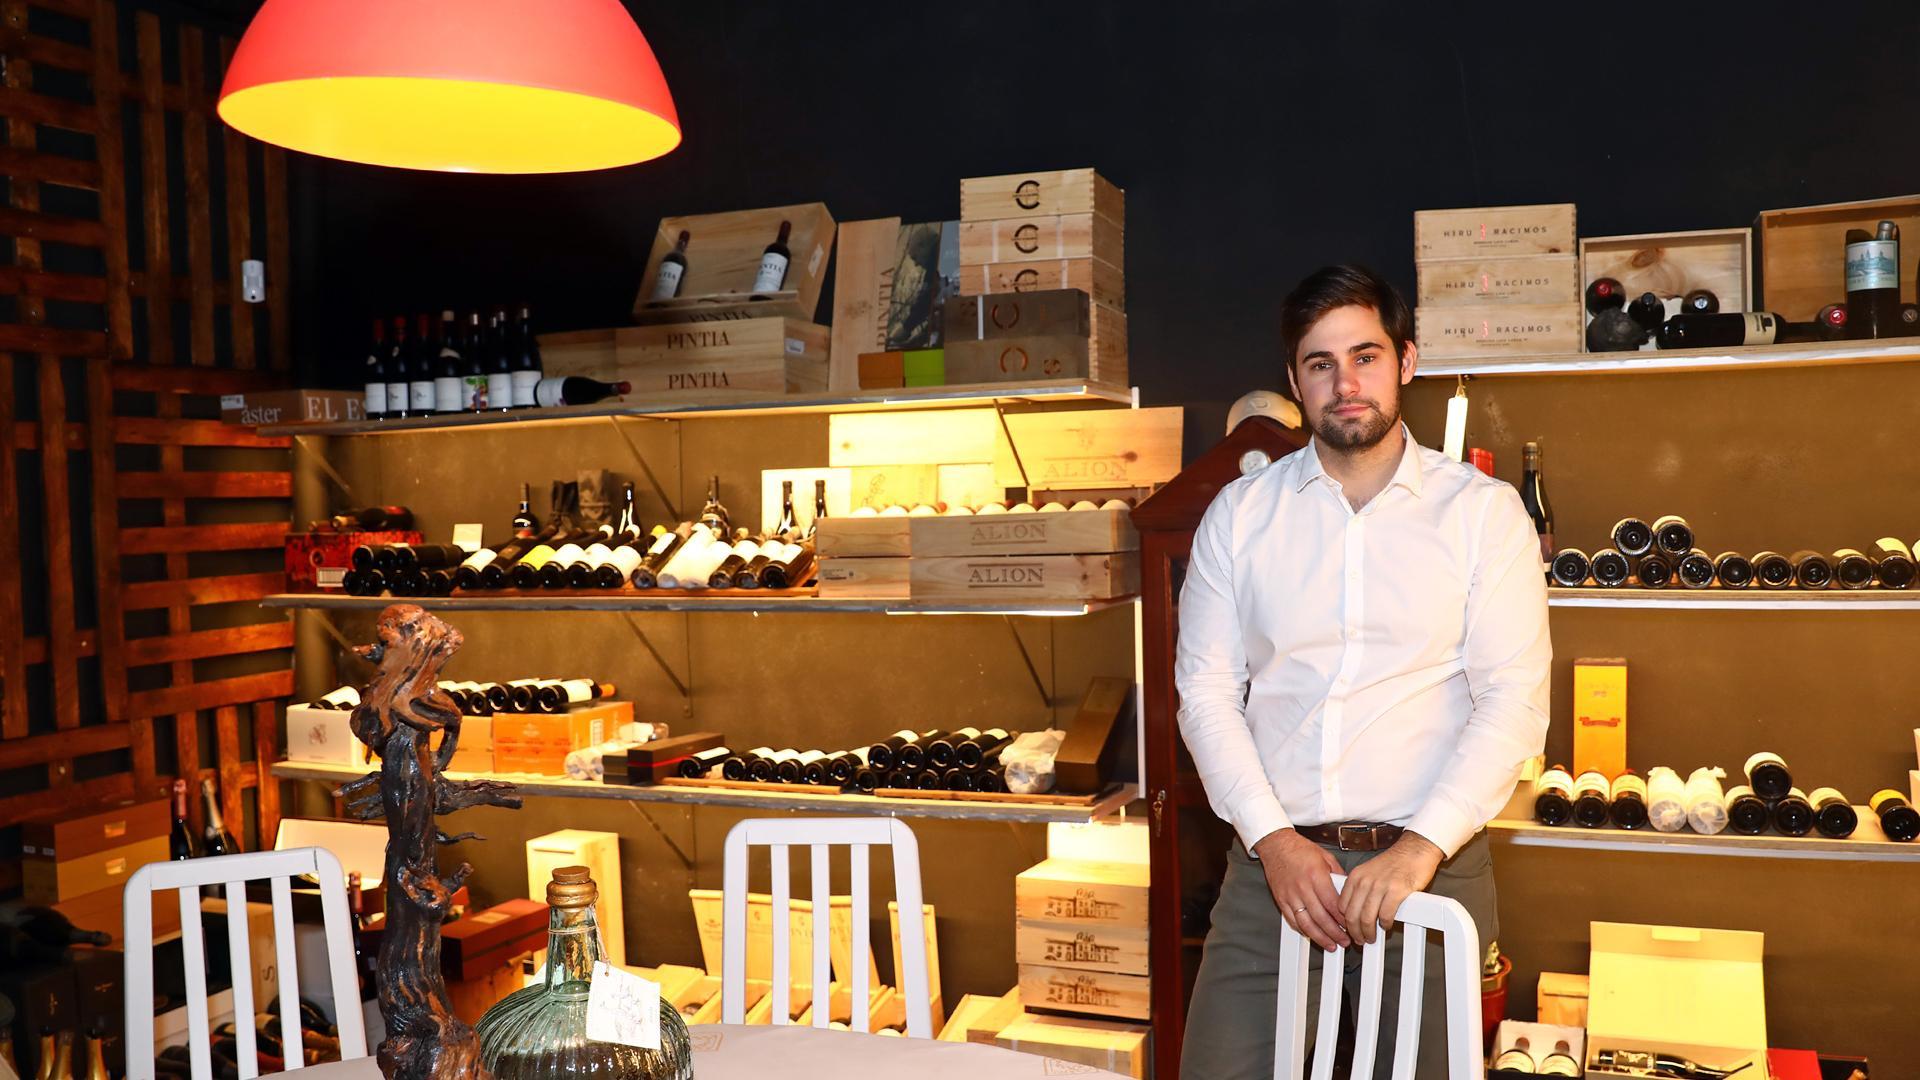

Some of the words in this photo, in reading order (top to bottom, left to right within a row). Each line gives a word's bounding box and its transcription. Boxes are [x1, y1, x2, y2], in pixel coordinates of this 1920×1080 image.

[1493, 226, 1547, 235] RACIMOS
[1445, 281, 1474, 289] HIRU
[1495, 278, 1549, 287] RACIMOS
[878, 267, 895, 347] PINTIA
[1496, 325, 1551, 333] RACIMOS
[666, 331, 730, 350] PINTIA
[667, 371, 730, 390] PINTIA
[306, 396, 338, 420] EL
[1043, 462, 1128, 477] ALION
[971, 524, 1047, 540] ALION
[968, 568, 1044, 583] ALION
